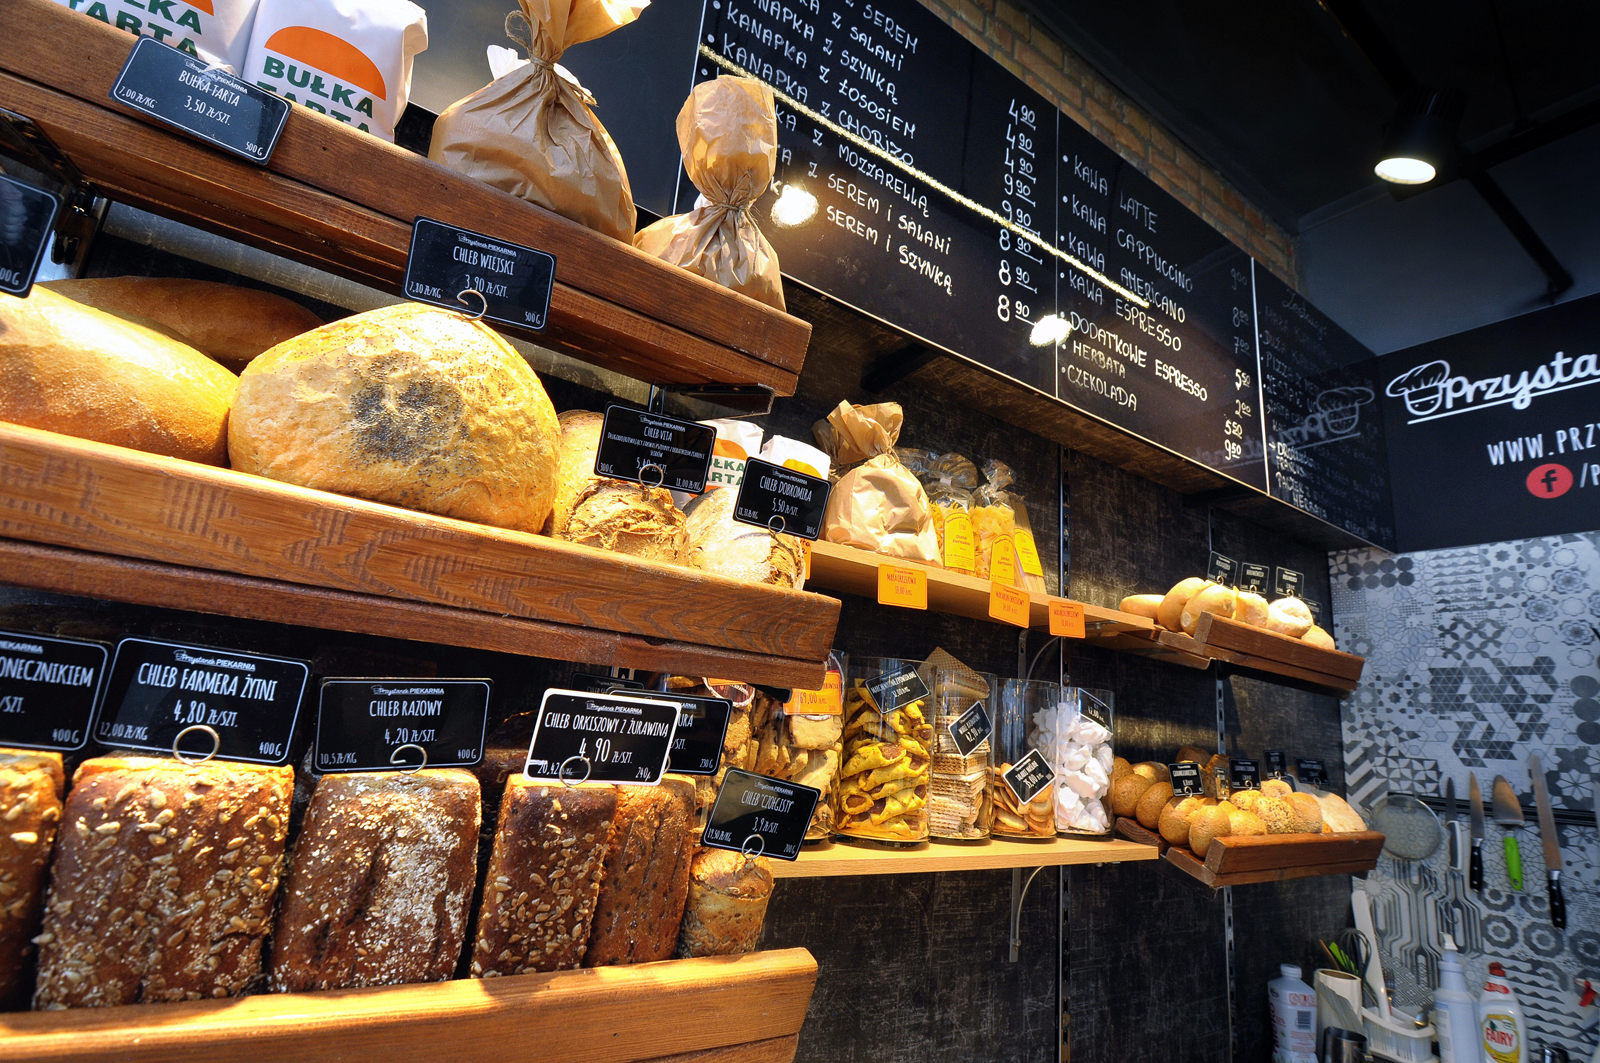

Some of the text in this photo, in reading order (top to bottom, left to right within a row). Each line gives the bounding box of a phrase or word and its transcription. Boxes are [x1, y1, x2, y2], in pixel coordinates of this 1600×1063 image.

[727, 1, 807, 69] KANAPKA
[863, 4, 918, 54] SEREM
[753, 0, 815, 41] NAPKA
[840, 49, 898, 105] SZYNKĄ
[723, 33, 808, 103] KANAPKA
[216, 75, 248, 95] PIEKARNIA
[263, 56, 373, 119] BUŁKA
[184, 95, 206, 114] 3,50
[245, 141, 258, 154] 500
[827, 173, 880, 214] SEREM
[1074, 154, 1158, 233] KAWA LATTE
[487, 243, 517, 257] PIEKARNIA
[826, 205, 878, 245] SEREM
[898, 245, 953, 296] SZYNKĄ
[1069, 232, 1105, 272] KAWA
[1072, 194, 1193, 292] KAWA CAPPUCCINO
[453, 246, 515, 276] CHLEB WIEJSKI
[11, 272, 20, 286] G
[1069, 270, 1182, 351] KAWA ESPRESSO
[1070, 311, 1208, 401] DODATKOWE ESPRESSO
[1073, 340, 1126, 378] HERBATA
[1067, 364, 1137, 411] CZEKOLADA
[643, 426, 673, 441] CHLEB VITA
[1487, 422, 1600, 466] WWW.PRZ
[759, 475, 777, 492] CHLEB
[215, 659, 256, 672] PIEKARNIA
[138, 662, 278, 702] CHLEB FARMERA ŻYTNI
[409, 687, 445, 695] PIEKARNIA
[173, 699, 206, 724] 4,80
[369, 700, 442, 717] CHLEB RAZOWY
[614, 705, 643, 715] PIEKARNIA
[52, 728, 71, 742] 400
[384, 727, 409, 746] 4,20
[544, 711, 669, 738] CHLEB ORKISZOWY Z ŻURAWINĄ
[259, 741, 274, 756] 400
[457, 748, 471, 760] 400
[742, 790, 760, 807] CHLEB
[1485, 1027, 1514, 1047] FAIRY
